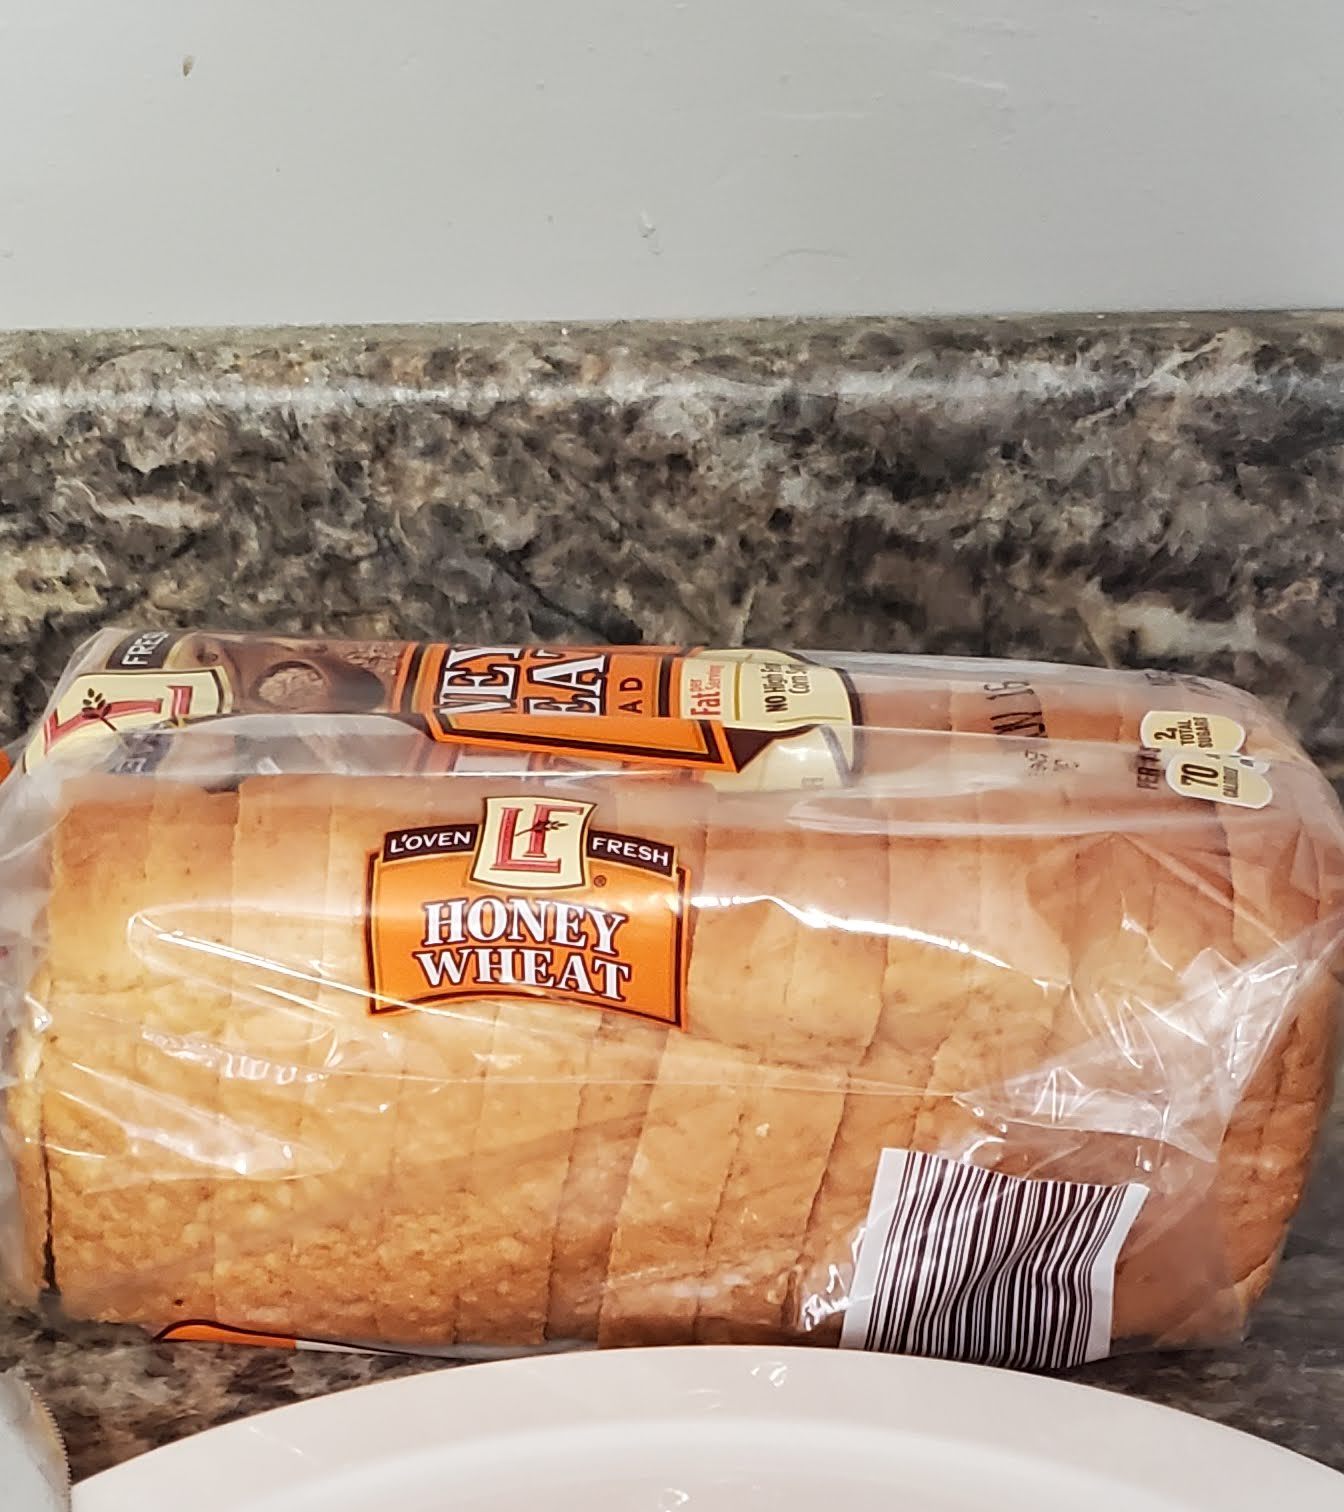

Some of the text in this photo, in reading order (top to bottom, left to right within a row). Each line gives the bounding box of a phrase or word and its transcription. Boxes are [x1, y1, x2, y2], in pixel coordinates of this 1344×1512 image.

[690, 691, 722, 716] Fat
[764, 695, 788, 713] NO
[1177, 719, 1196, 746] TOTAL
[1180, 763, 1219, 788] 70
[389, 831, 670, 866] L'OVEN FRESH
[422, 896, 627, 955] HONEY
[413, 946, 631, 1001] WHEAT
